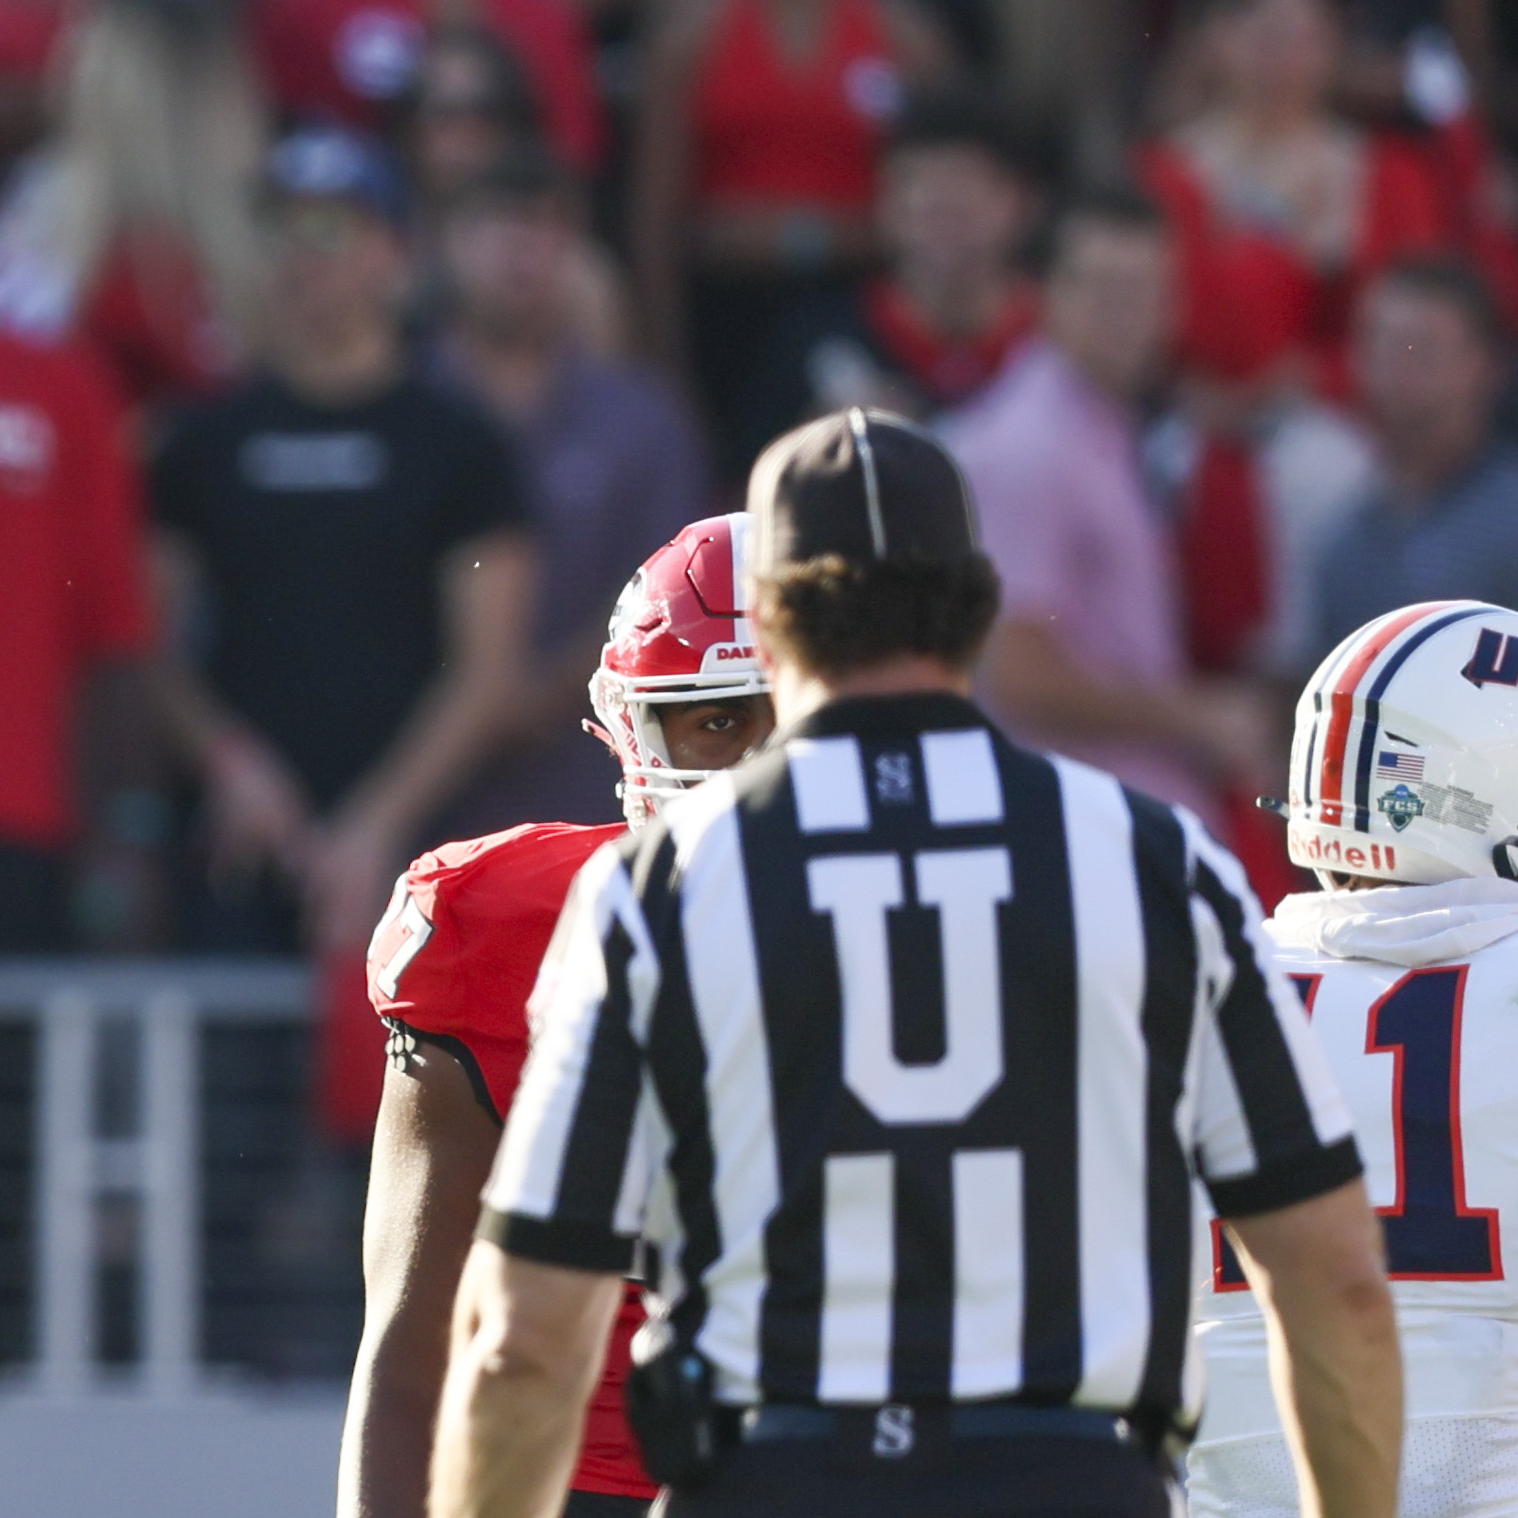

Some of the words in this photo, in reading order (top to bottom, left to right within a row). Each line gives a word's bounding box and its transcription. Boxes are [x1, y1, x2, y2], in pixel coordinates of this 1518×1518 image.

[1383, 799, 1419, 812] FCS
[1290, 829, 1396, 872] Riddell
[806, 846, 1014, 1126] U
